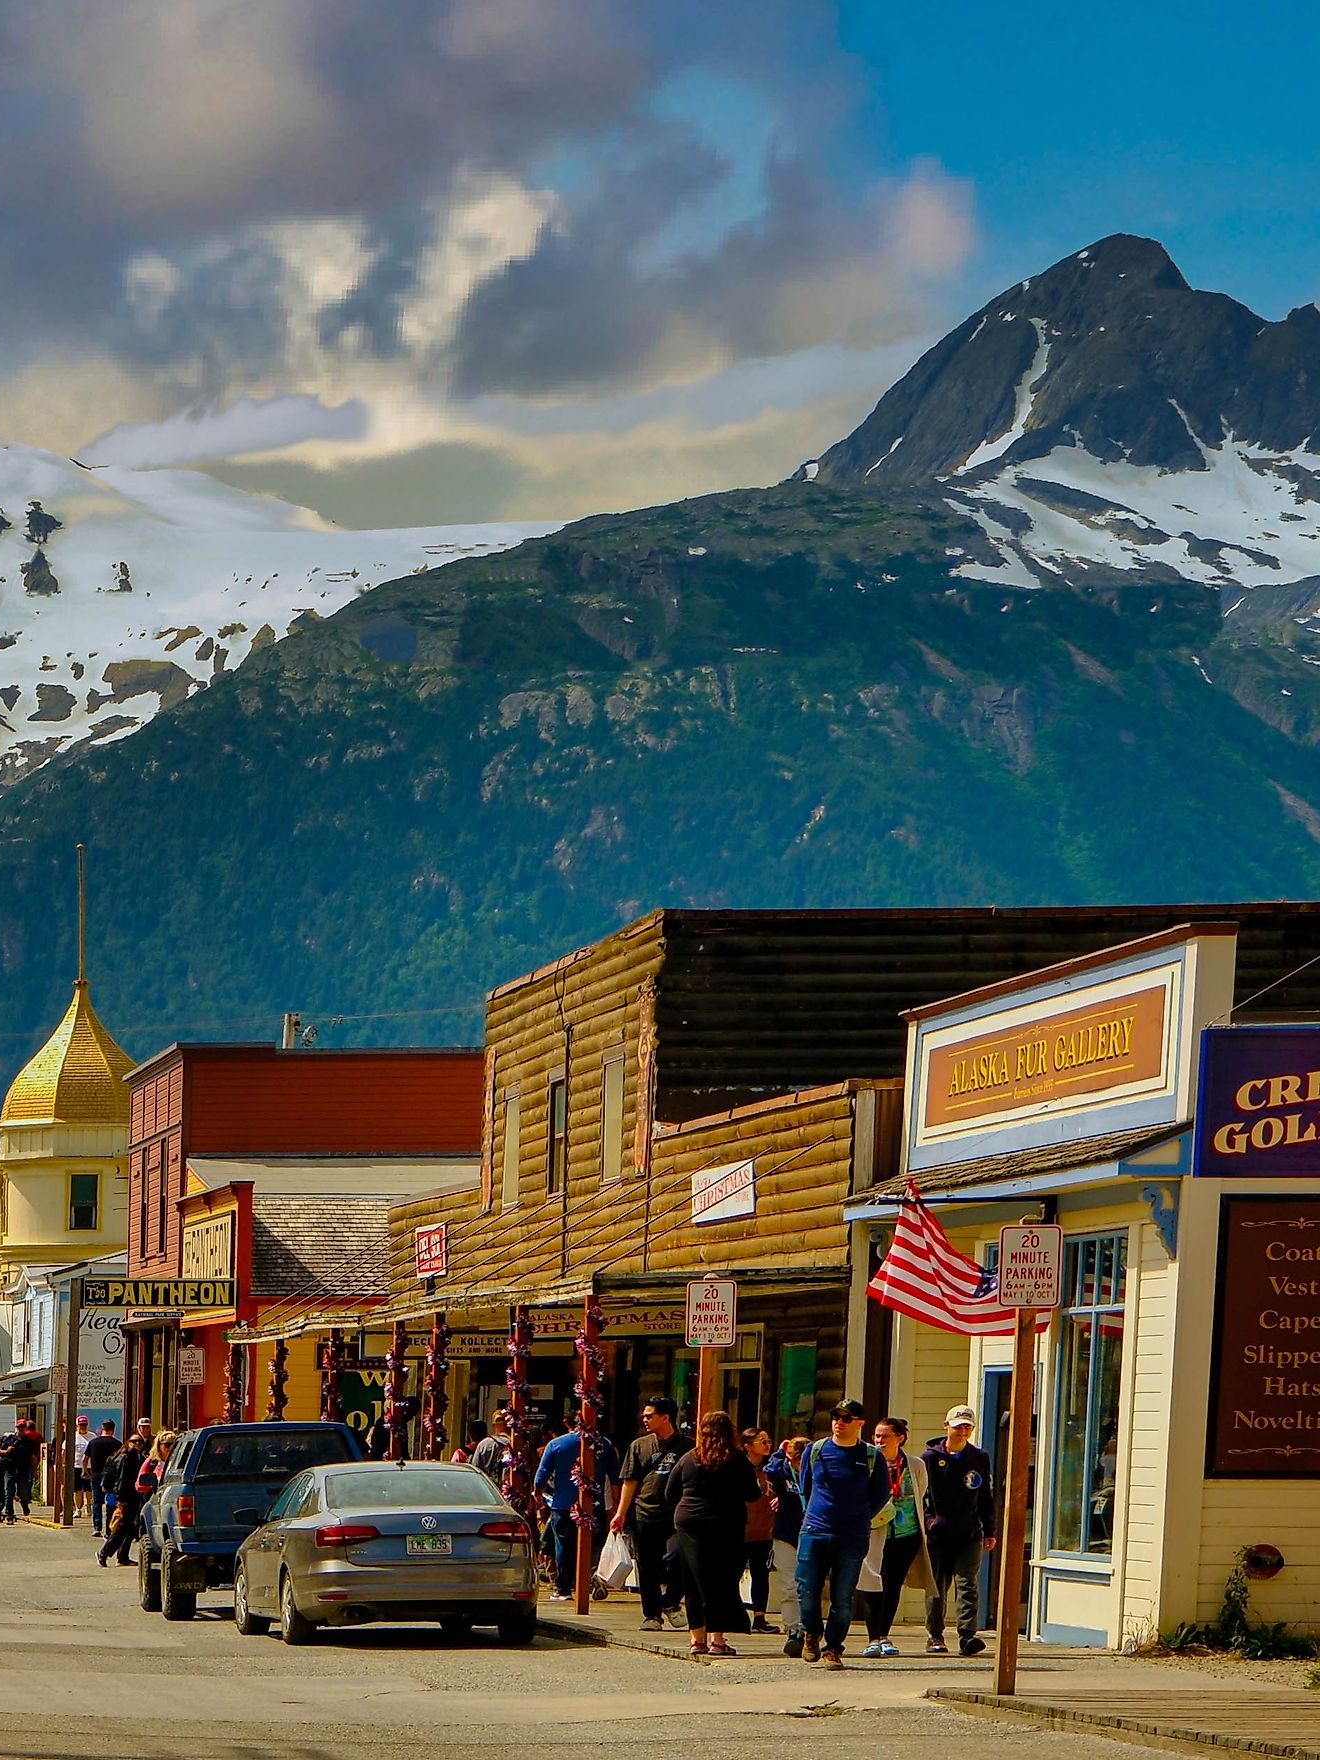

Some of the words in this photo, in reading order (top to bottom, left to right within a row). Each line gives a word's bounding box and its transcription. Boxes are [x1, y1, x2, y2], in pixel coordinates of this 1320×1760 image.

[948, 1051, 1009, 1097] ALASKA
[1015, 1039, 1048, 1082] FUR
[1053, 1016, 1134, 1072] GALLERY
[1213, 1113, 1320, 1154] GOL
[693, 1168, 751, 1212] CHRISTMAS
[1021, 1234, 1040, 1248] 20
[1010, 1252, 1049, 1264] MINUTE
[1006, 1267, 1053, 1280] PARKING
[86, 1286, 106, 1300] The
[108, 1282, 230, 1305] PANTHEON
[704, 1288, 719, 1299] 20
[1003, 1291, 1017, 1299] MAY
[1036, 1291, 1050, 1299] OCT
[696, 1302, 726, 1311] MINUTE
[530, 1313, 575, 1321] ALASKA
[692, 1314, 729, 1324] PARKING
[643, 1323, 681, 1331] STORE
[1263, 1376, 1320, 1396] Hats
[431, 1539, 448, 1550] 835
